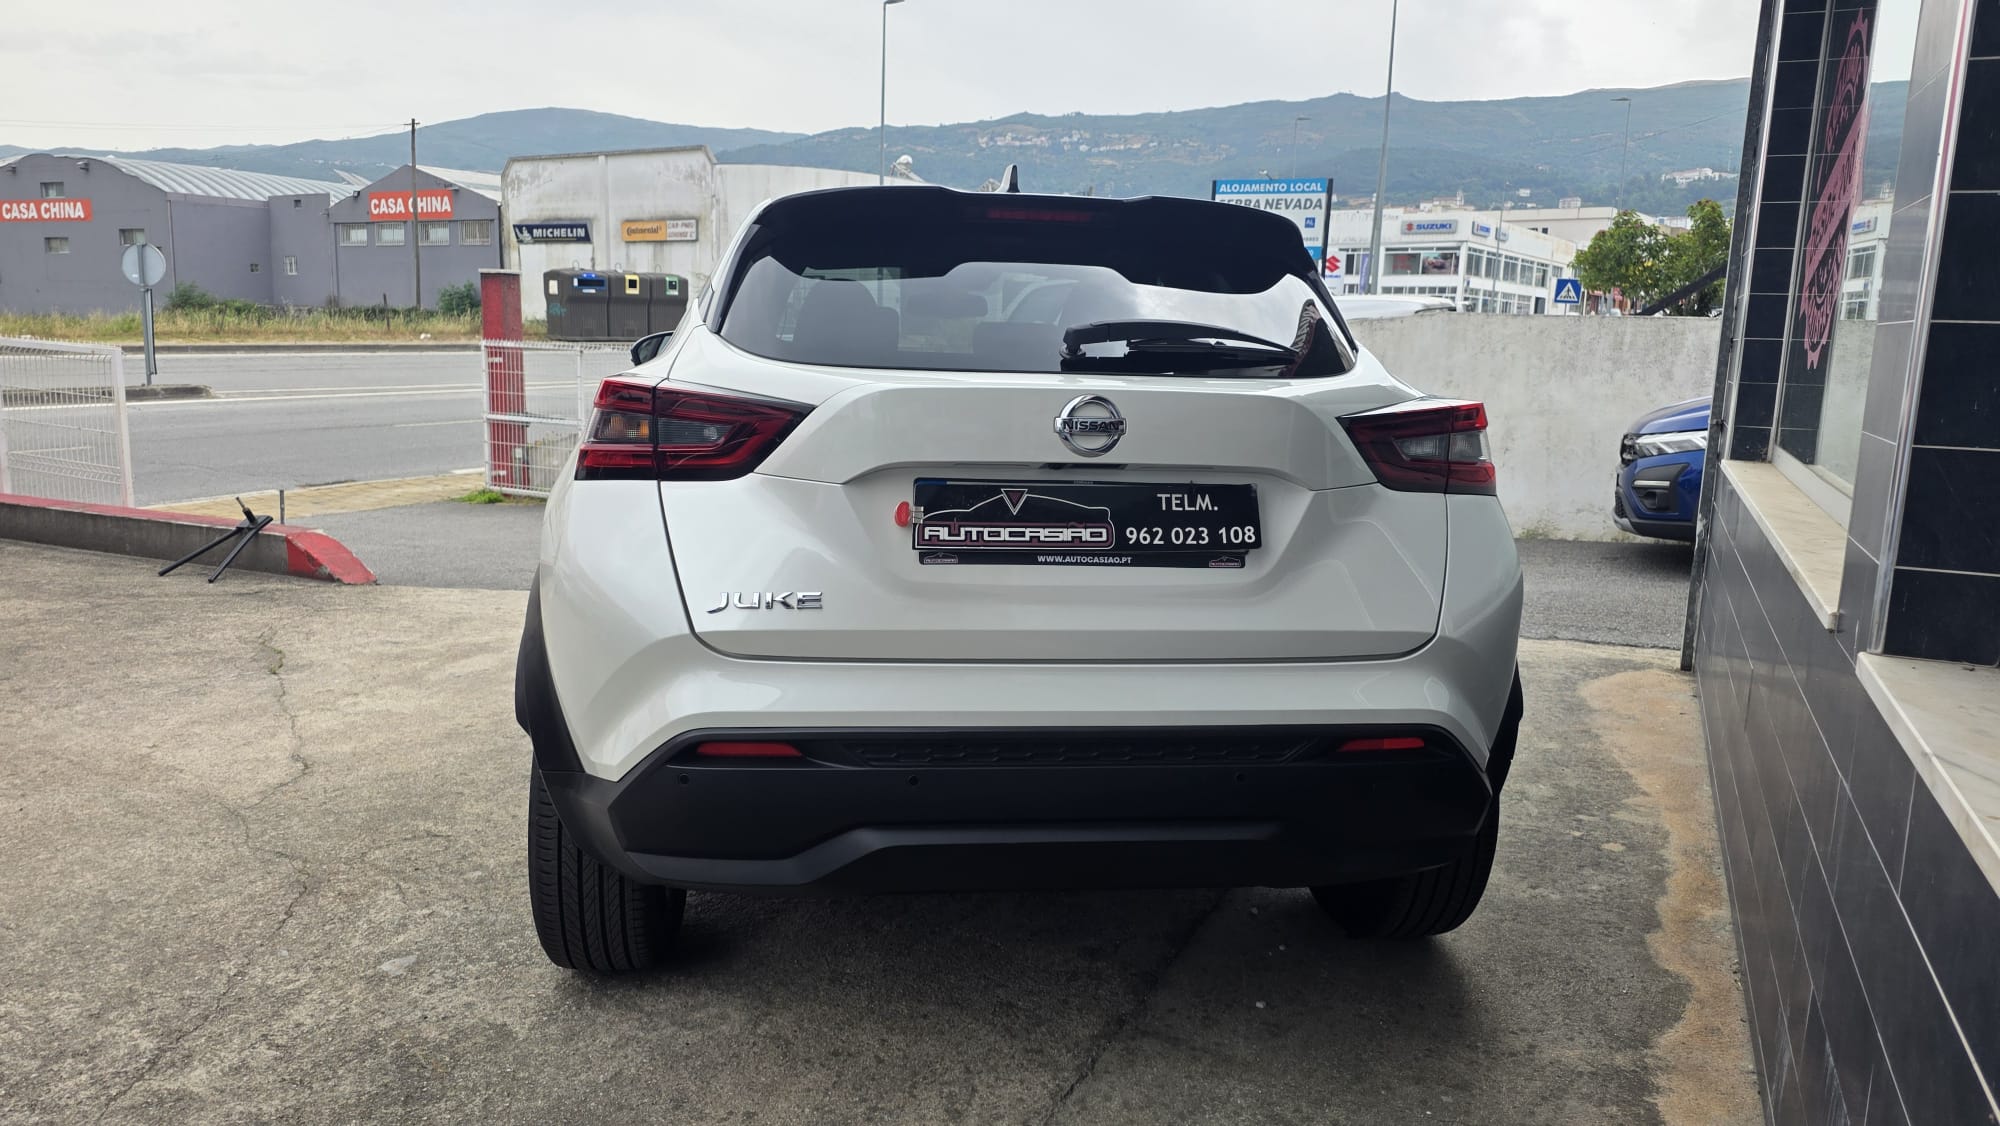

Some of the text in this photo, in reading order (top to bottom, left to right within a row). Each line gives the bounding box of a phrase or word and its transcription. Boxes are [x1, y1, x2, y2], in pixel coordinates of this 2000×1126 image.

[1220, 182, 1322, 193] ALOJAMENTO LOCAL
[2, 202, 85, 219] CASA CHINA
[371, 198, 405, 215] CASA
[1264, 198, 1323, 210] NEVADA
[533, 227, 586, 238] MICHELIN
[1063, 420, 1120, 431] NISSAN
[1157, 493, 1219, 511] TELM.
[1126, 526, 1256, 545] 962 023 108
[1037, 555, 1132, 564] WWW.AUTOCASIAO.PT
[706, 592, 823, 614] JUKE
